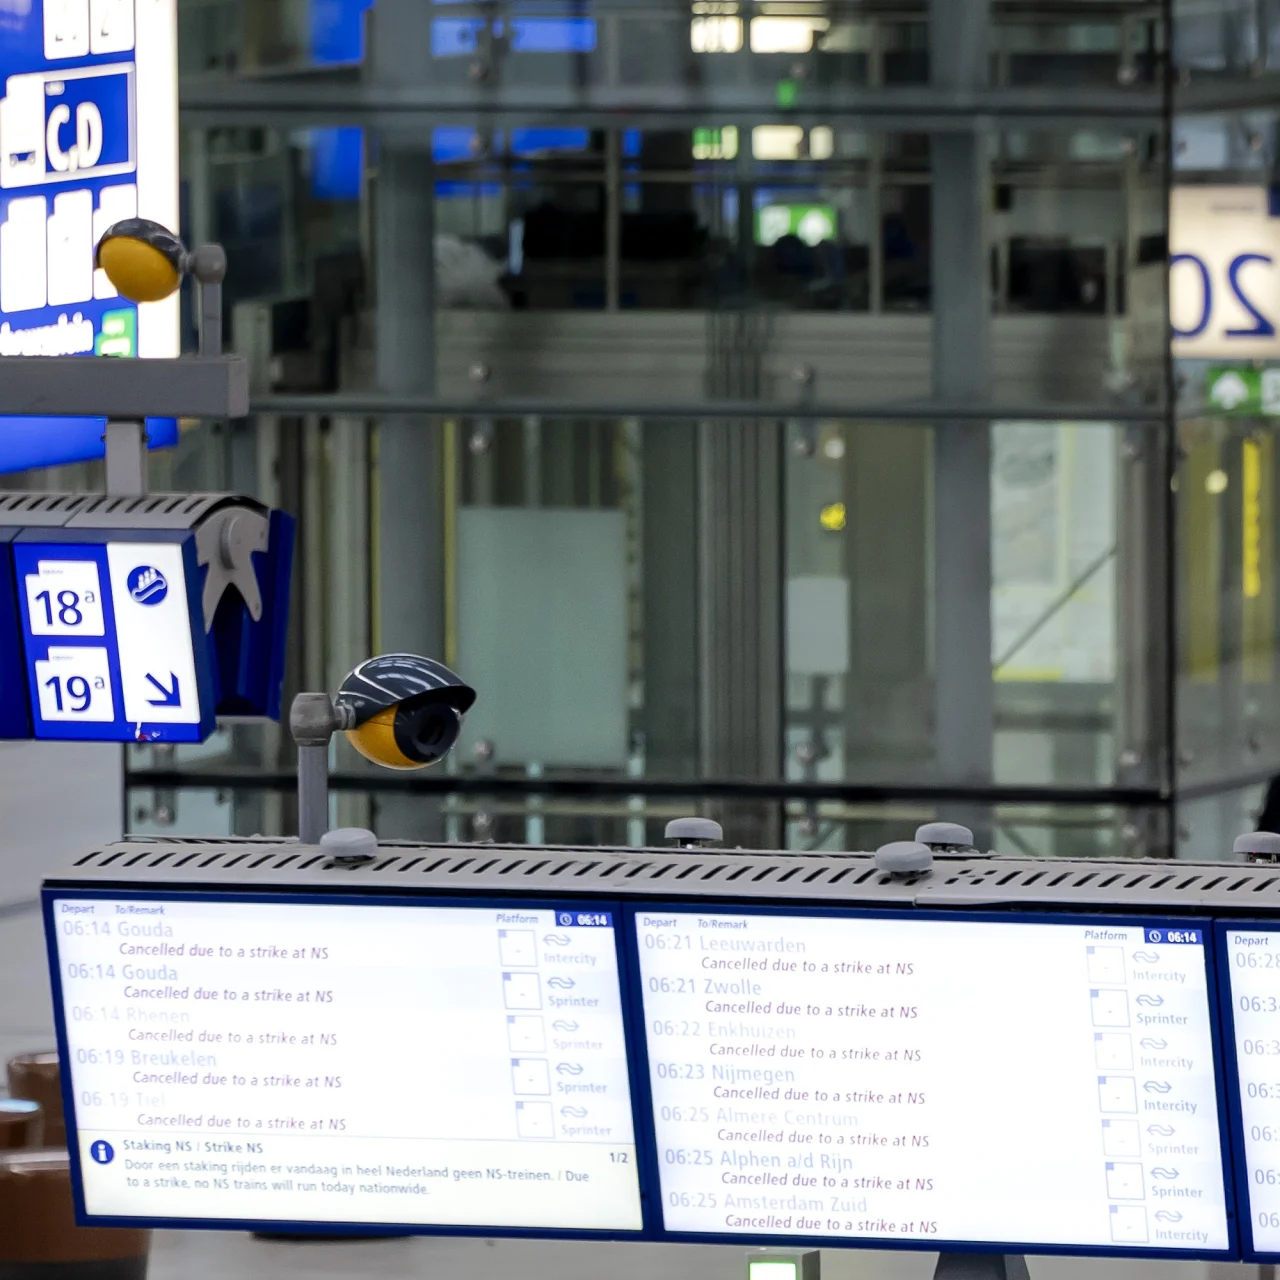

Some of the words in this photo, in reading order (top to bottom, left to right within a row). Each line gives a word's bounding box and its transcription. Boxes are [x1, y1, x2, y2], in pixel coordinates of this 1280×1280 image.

[62, 904, 94, 915] Depart
[116, 905, 164, 915] To/Remark
[496, 914, 538, 923] Platform
[644, 917, 677, 928] Depart
[698, 919, 748, 928] To/Remark
[63, 920, 111, 935] 06:14
[118, 921, 173, 937] Gouda
[1085, 930, 1127, 940] Platform
[645, 934, 690, 949] 06:21
[700, 936, 805, 952] Leeuwarden
[1168, 932, 1196, 942] 06:14
[1235, 936, 1268, 947] Depart
[119, 943, 184, 956] Cancelled
[190, 944, 213, 956] due
[219, 946, 232, 957] to
[237, 949, 245, 957] a
[250, 946, 287, 958] strike
[292, 948, 305, 958] at
[311, 947, 328, 959] NS
[544, 953, 597, 967] Intercity
[702, 957, 767, 970] Cancelled
[773, 959, 797, 971] due
[803, 961, 816, 972] to
[821, 964, 828, 972] a
[834, 961, 872, 973] strike
[877, 964, 890, 974] at
[896, 963, 913, 974] NS
[68, 963, 115, 979] 06:14
[122, 964, 178, 981] Gouda
[1133, 970, 1186, 984] Intercity
[649, 977, 694, 993] 06:21
[704, 979, 761, 995] Zwolle
[549, 996, 599, 1008] Sprinter
[1137, 1013, 1187, 1026] Sprinter
[653, 1020, 700, 1036] 06:22
[708, 1021, 795, 1039] Enkhuizen
[76, 1048, 124, 1065] 06:19
[131, 1050, 216, 1066] Breukelen
[1141, 1057, 1193, 1070] Intercity
[657, 1063, 704, 1079] 06:23
[712, 1065, 794, 1086] Nijmegen
[557, 1082, 607, 1095] Sprinter
[1144, 1100, 1197, 1114] Intercity
[661, 1106, 709, 1122] 06:25
[717, 1107, 776, 1123] Almere
[785, 1110, 857, 1126] Centrum
[123, 1140, 171, 1154] Staking
[176, 1141, 192, 1151] NS
[205, 1142, 242, 1153] Strike
[247, 1143, 263, 1153] NS
[1148, 1143, 1199, 1156] Sprinter
[610, 1153, 628, 1163] 1/2
[665, 1149, 713, 1165] 06:25
[721, 1150, 780, 1170] Alphen
[788, 1152, 813, 1168] a/d
[821, 1153, 852, 1173] Rijn
[125, 1159, 153, 1170] Door
[184, 1161, 227, 1175] staking
[232, 1162, 266, 1175] rijden
[286, 1164, 337, 1178] vandaag
[342, 1165, 352, 1174] in
[357, 1165, 381, 1176] heel
[386, 1166, 448, 1177] Nederland
[453, 1170, 482, 1181] geen
[566, 1171, 589, 1181] Due
[127, 1177, 139, 1187] to
[144, 1179, 150, 1187] a
[194, 1180, 209, 1188] no
[213, 1178, 229, 1189] NS
[234, 1180, 267, 1190] trains
[272, 1180, 293, 1190] will
[298, 1183, 317, 1191] run
[321, 1181, 355, 1195] today
[1152, 1186, 1203, 1199] Sprinter
[669, 1192, 717, 1208] 06:25
[725, 1193, 823, 1211] Amsterdam
[830, 1196, 866, 1212] Zuid
[1156, 1229, 1208, 1243] Intercity
